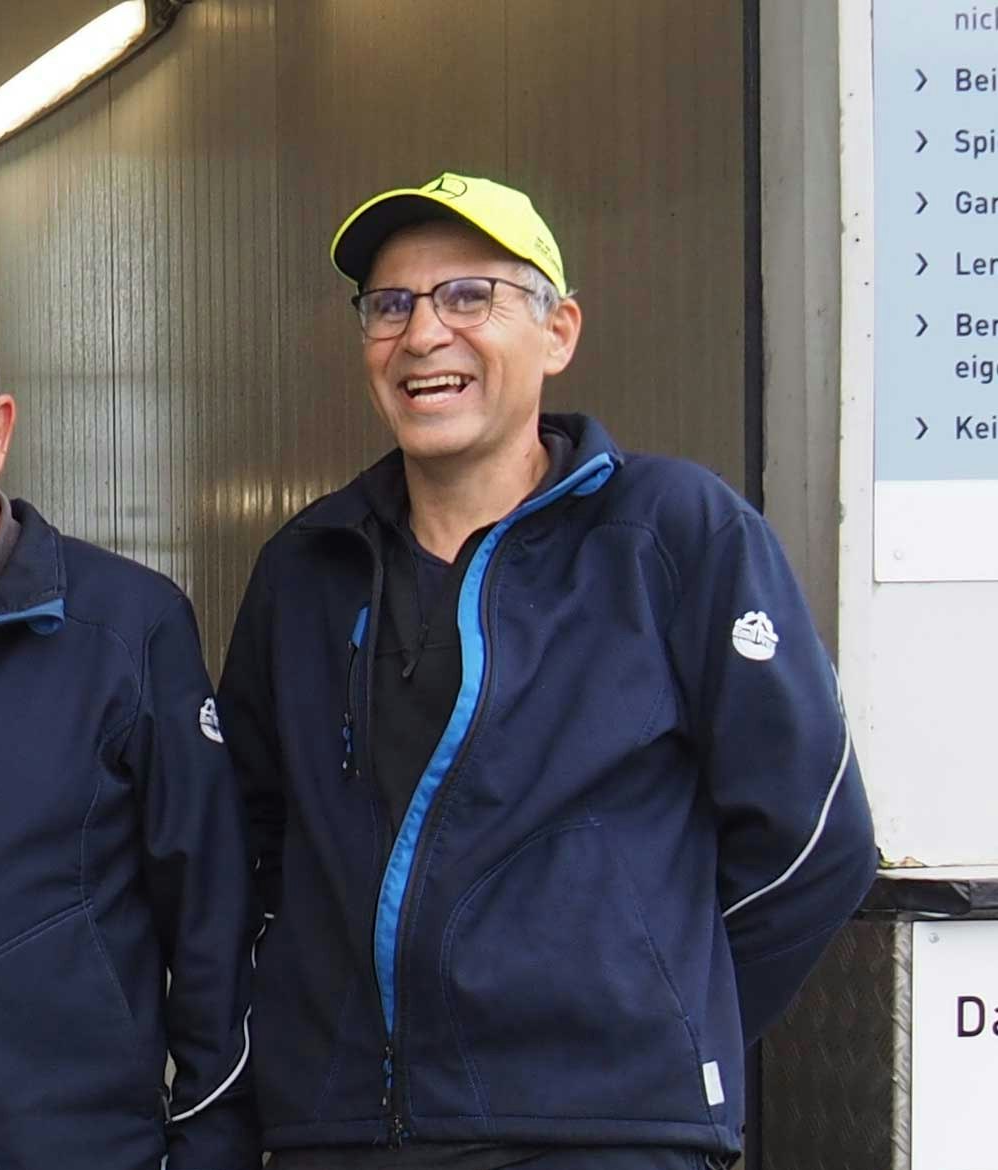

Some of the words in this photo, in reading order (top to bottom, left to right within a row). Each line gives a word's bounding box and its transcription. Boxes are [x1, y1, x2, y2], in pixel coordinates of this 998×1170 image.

[955, 67, 997, 92] Bei
[954, 128, 998, 160] Spi
[955, 354, 998, 384] eig
[956, 415, 997, 440] Kei
[957, 995, 998, 1037] D
